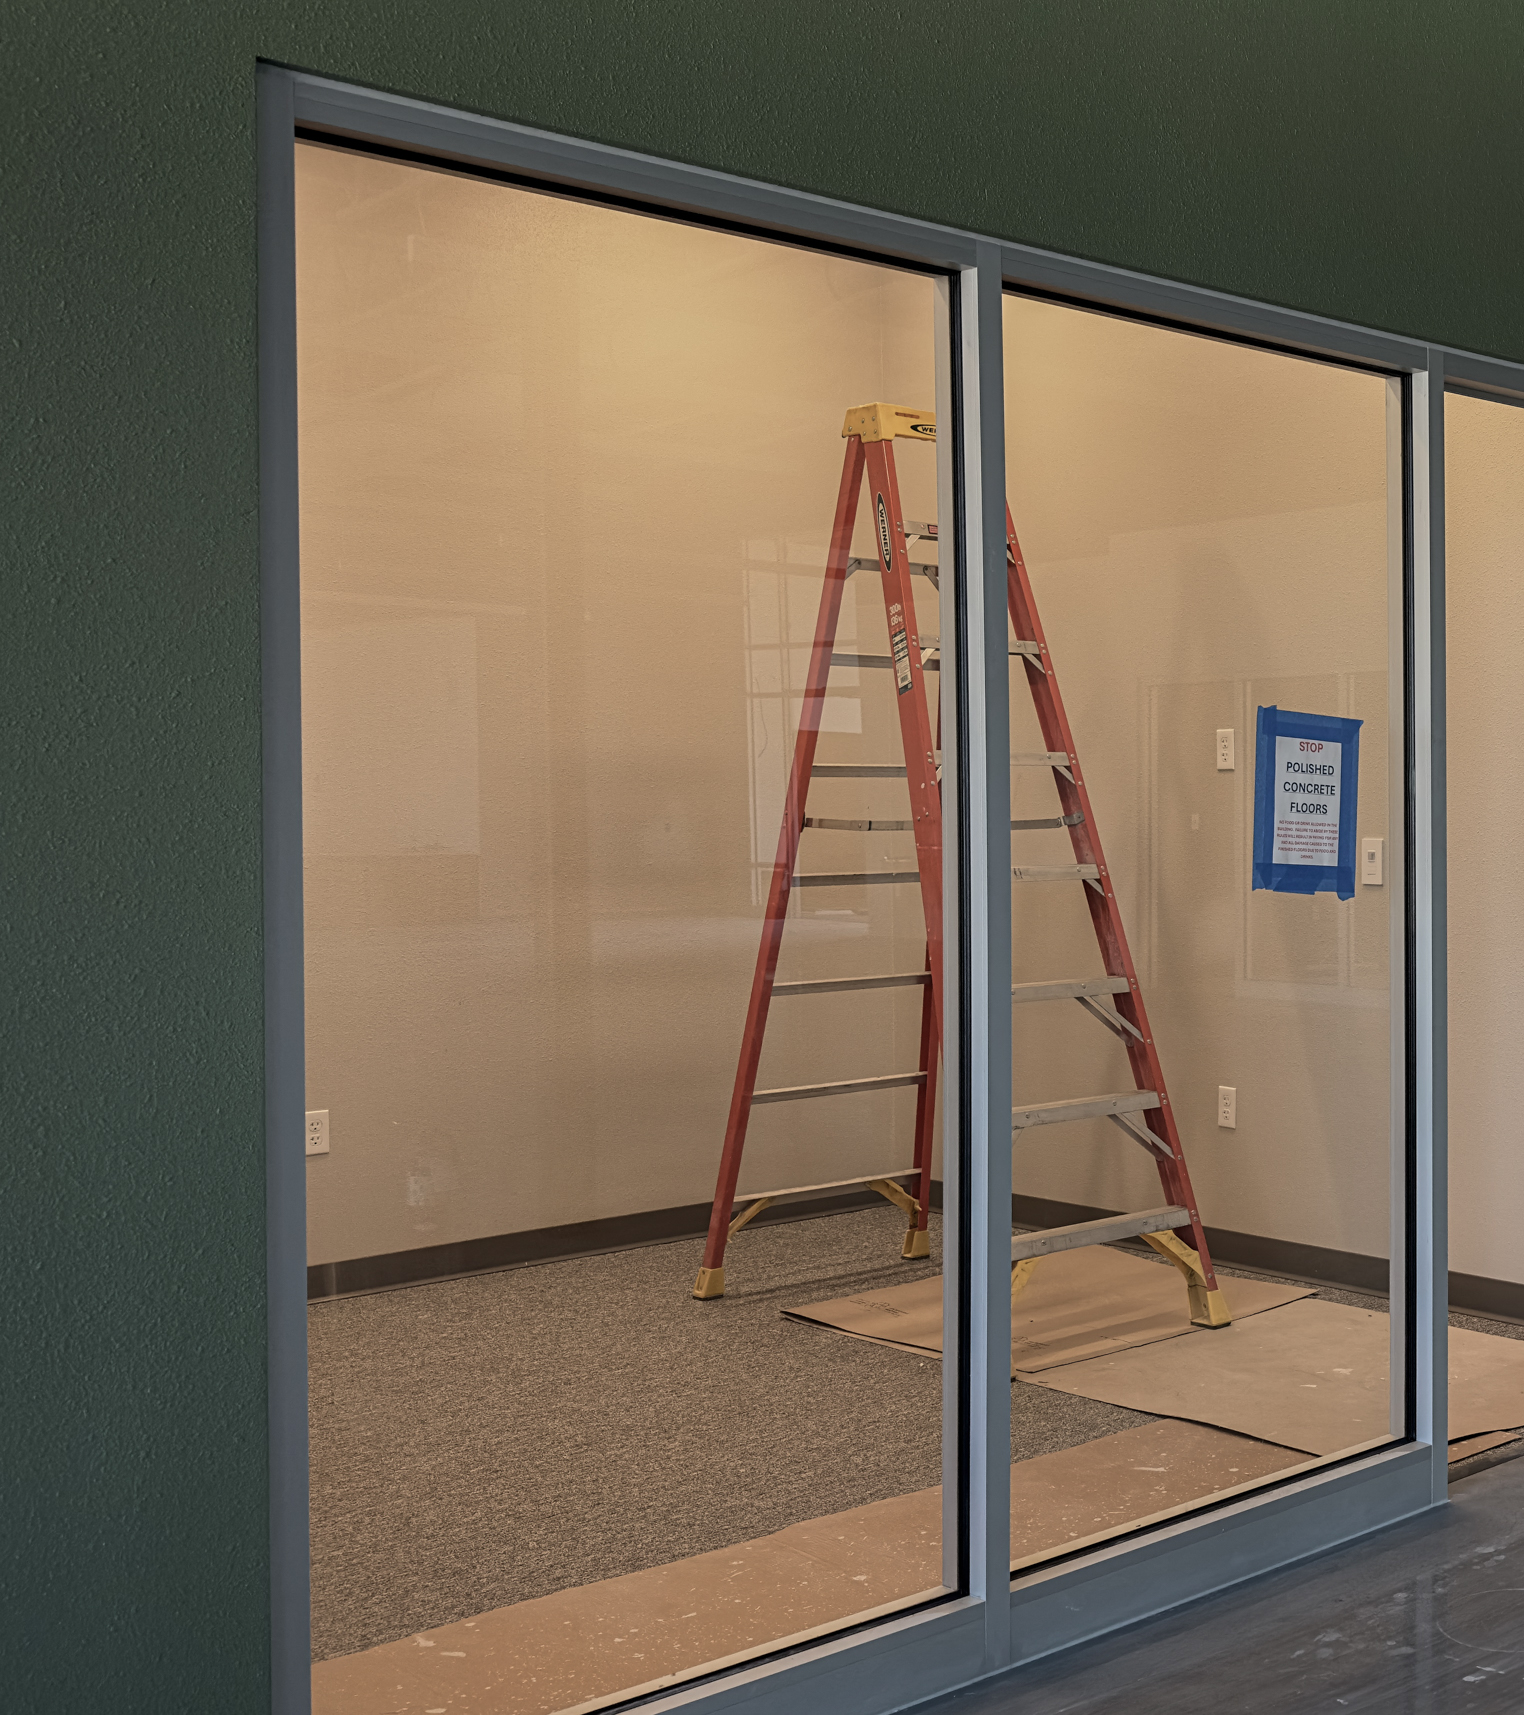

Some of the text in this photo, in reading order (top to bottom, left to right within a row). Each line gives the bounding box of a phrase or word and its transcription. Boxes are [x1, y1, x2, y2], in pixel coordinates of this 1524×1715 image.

[879, 508, 889, 556] WERNER
[1299, 741, 1323, 753] STOP
[1286, 761, 1335, 776] POLISHED
[1283, 781, 1336, 796] CONCRETE
[1290, 802, 1328, 815] FLOORS
